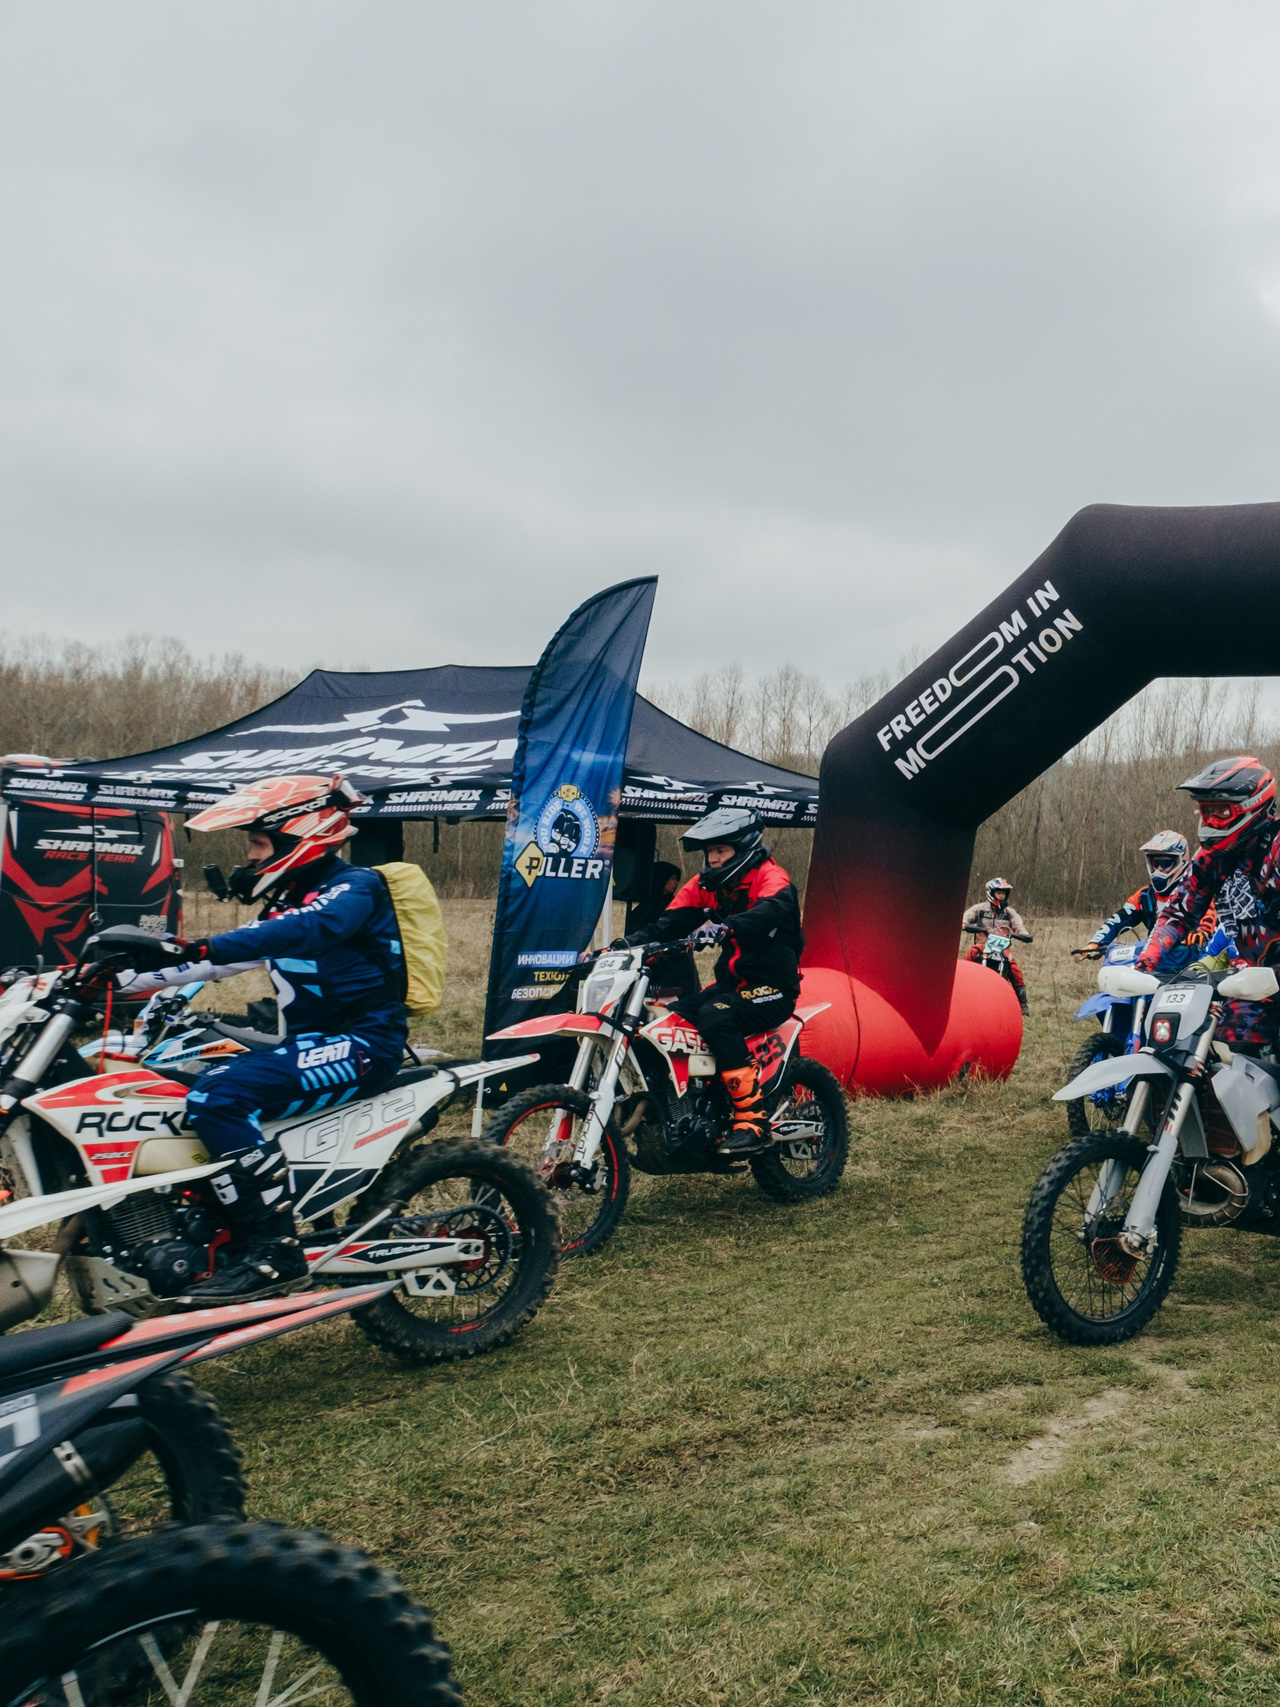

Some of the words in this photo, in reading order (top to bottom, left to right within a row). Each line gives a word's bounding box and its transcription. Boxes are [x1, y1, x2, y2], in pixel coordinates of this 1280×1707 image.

[877, 610, 1028, 752] FREEDOM
[1026, 580, 1060, 618] IN
[894, 608, 1083, 780] MOTION
[7, 778, 88, 793] SHARMAX
[98, 784, 179, 800] SHARMAX
[386, 789, 483, 804] SHARMAX
[622, 785, 714, 803] SHARMAX
[442, 802, 477, 811] RACE
[677, 803, 707, 812] RACE
[719, 794, 799, 812] SHARMAX
[767, 811, 793, 820] RACE
[34, 839, 145, 855] SHARMAX
[44, 850, 89, 862] RACE
[96, 854, 138, 864] TEAM
[517, 953, 574, 966] ИННОВАЦИИ
[1165, 993, 1186, 1004] 133
[91, 1151, 132, 1161] 250CC
